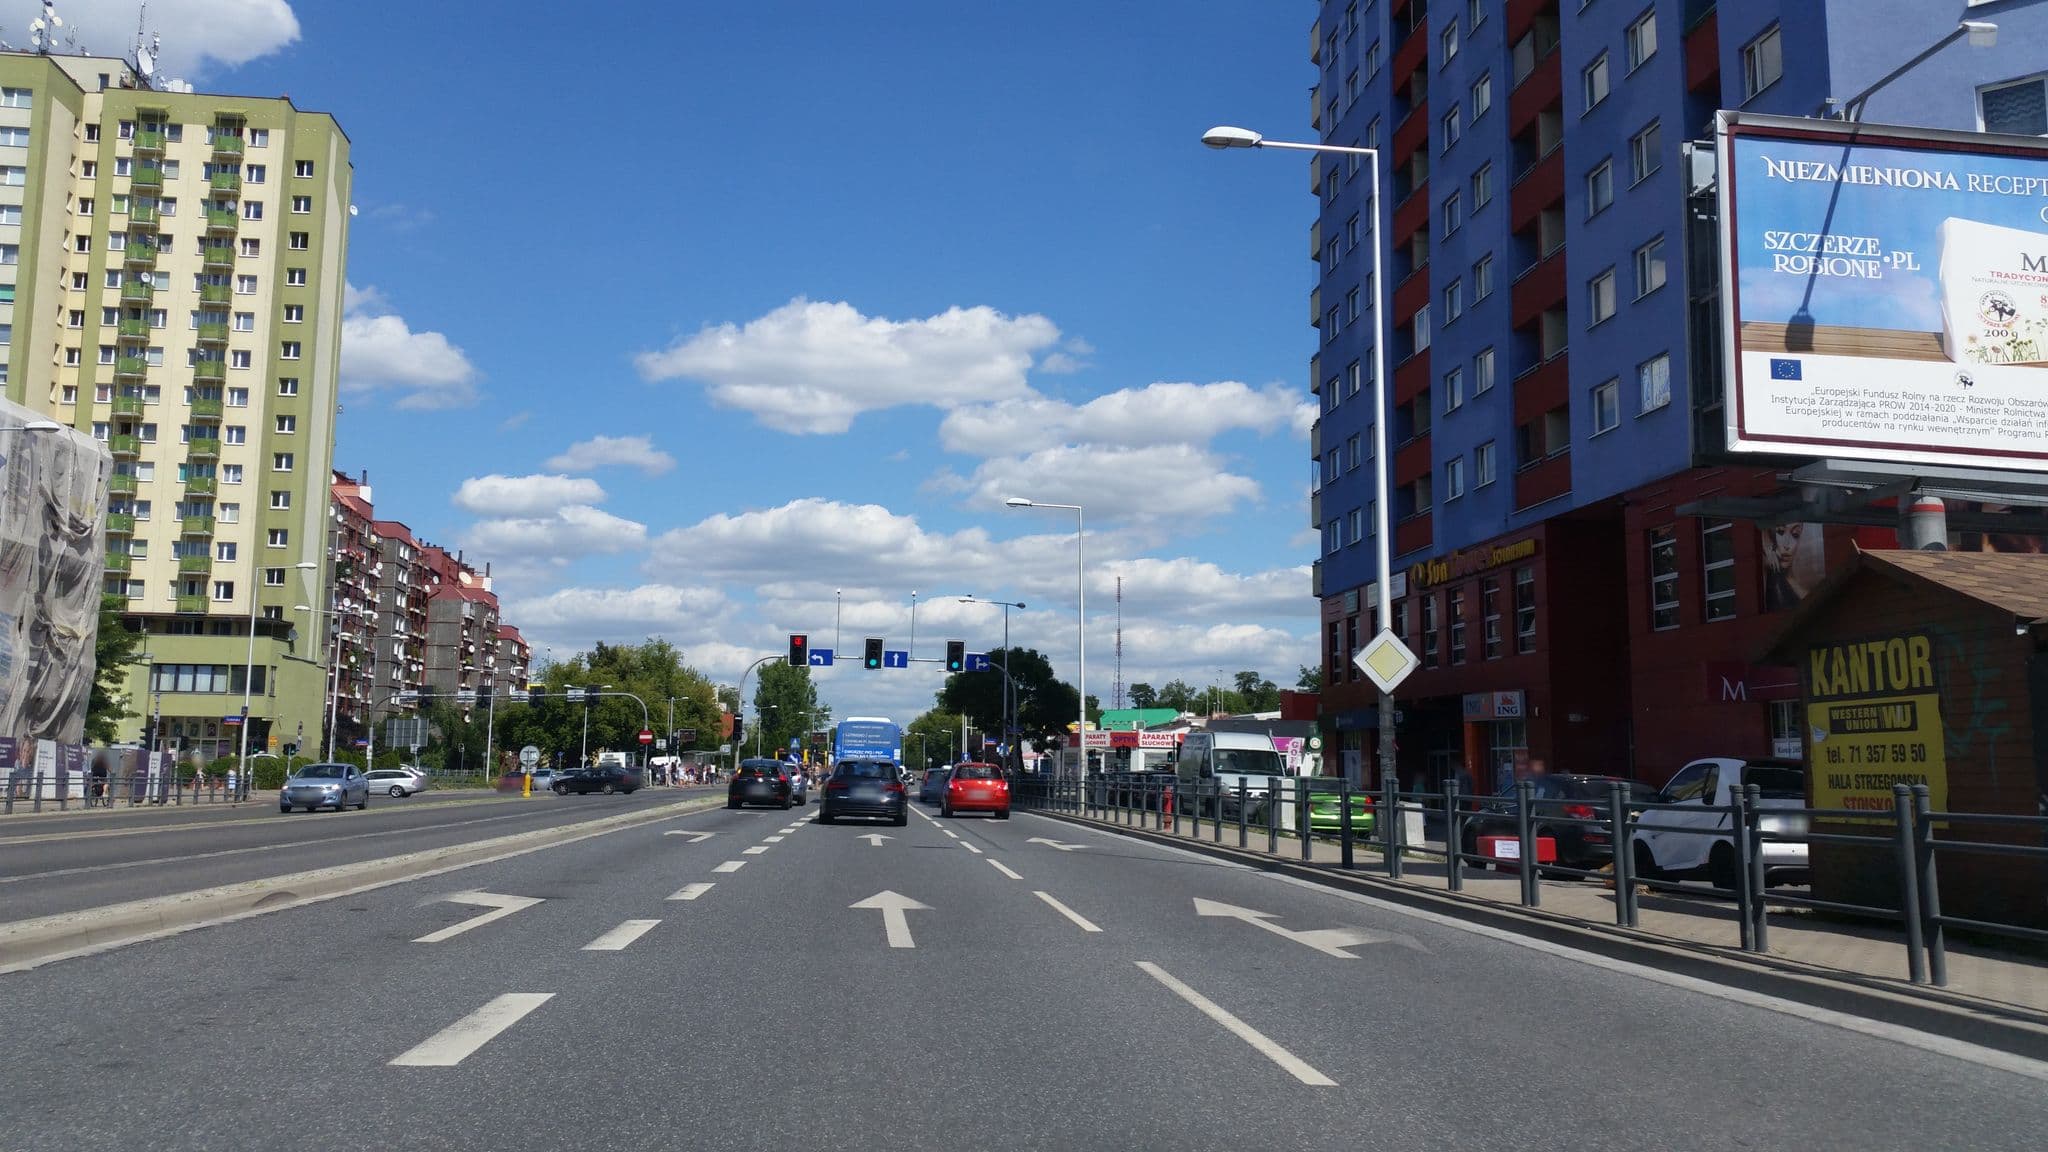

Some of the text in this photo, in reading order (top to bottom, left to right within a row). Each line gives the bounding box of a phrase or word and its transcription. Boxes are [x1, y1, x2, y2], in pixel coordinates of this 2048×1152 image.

[1760, 156, 1960, 190] NIEZMIENIONA
[1764, 231, 1881, 256] SZCZERZE
[1773, 254, 1882, 278] ROBIONE
[1984, 329, 2009, 337] 200
[1771, 394, 1816, 406] Instytucja
[1819, 397, 1876, 408] Zarządzająca
[1879, 400, 1906, 410] PROW
[1909, 402, 1956, 413] 2014-2020
[1966, 405, 2000, 415] Minister
[2003, 408, 2046, 418] Rolnictwa
[1863, 389, 1899, 399] Fundusz
[1902, 391, 1926, 402] Rolny
[1943, 395, 1965, 403] rzecz
[1968, 395, 2004, 406] Rozwoju
[1785, 406, 1842, 418] Europejskiej
[1856, 410, 1890, 419] ramach
[1892, 412, 1949, 423] poddziałania
[2000, 417, 2033, 427] działań
[1821, 418, 1880, 429] producentów
[1884, 422, 1895, 430] na
[1898, 422, 1924, 432] rynku
[1997, 428, 2041, 438] Programu
[1809, 635, 1934, 697] KANTOR
[1721, 675, 1747, 701] M
[1497, 706, 1518, 715] ING
[1831, 704, 1912, 729] WESTERN WU
[1845, 718, 1879, 731] UNION
[1827, 743, 1926, 763] tel. 71 357 59 50
[1828, 774, 1852, 789] HALA
